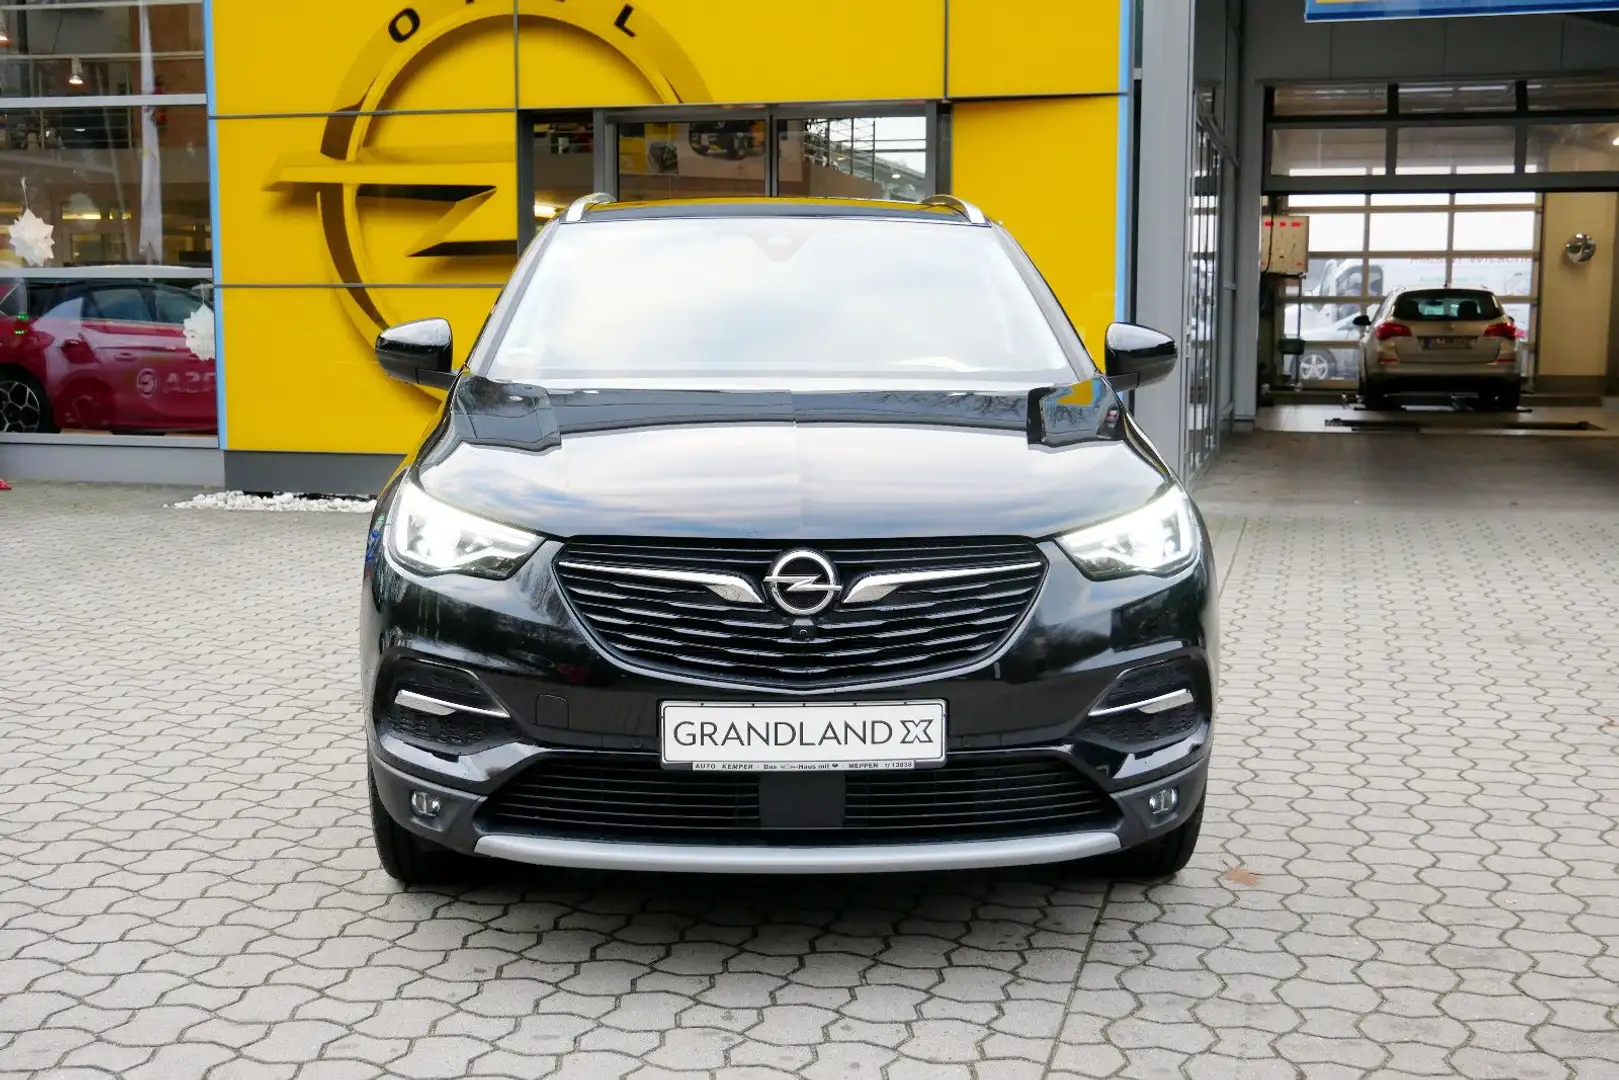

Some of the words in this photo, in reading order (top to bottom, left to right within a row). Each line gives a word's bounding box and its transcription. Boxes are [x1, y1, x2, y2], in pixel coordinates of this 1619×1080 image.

[388, 0, 637, 43] OL
[673, 720, 893, 746] GRANDLAND
[900, 719, 934, 744] X
